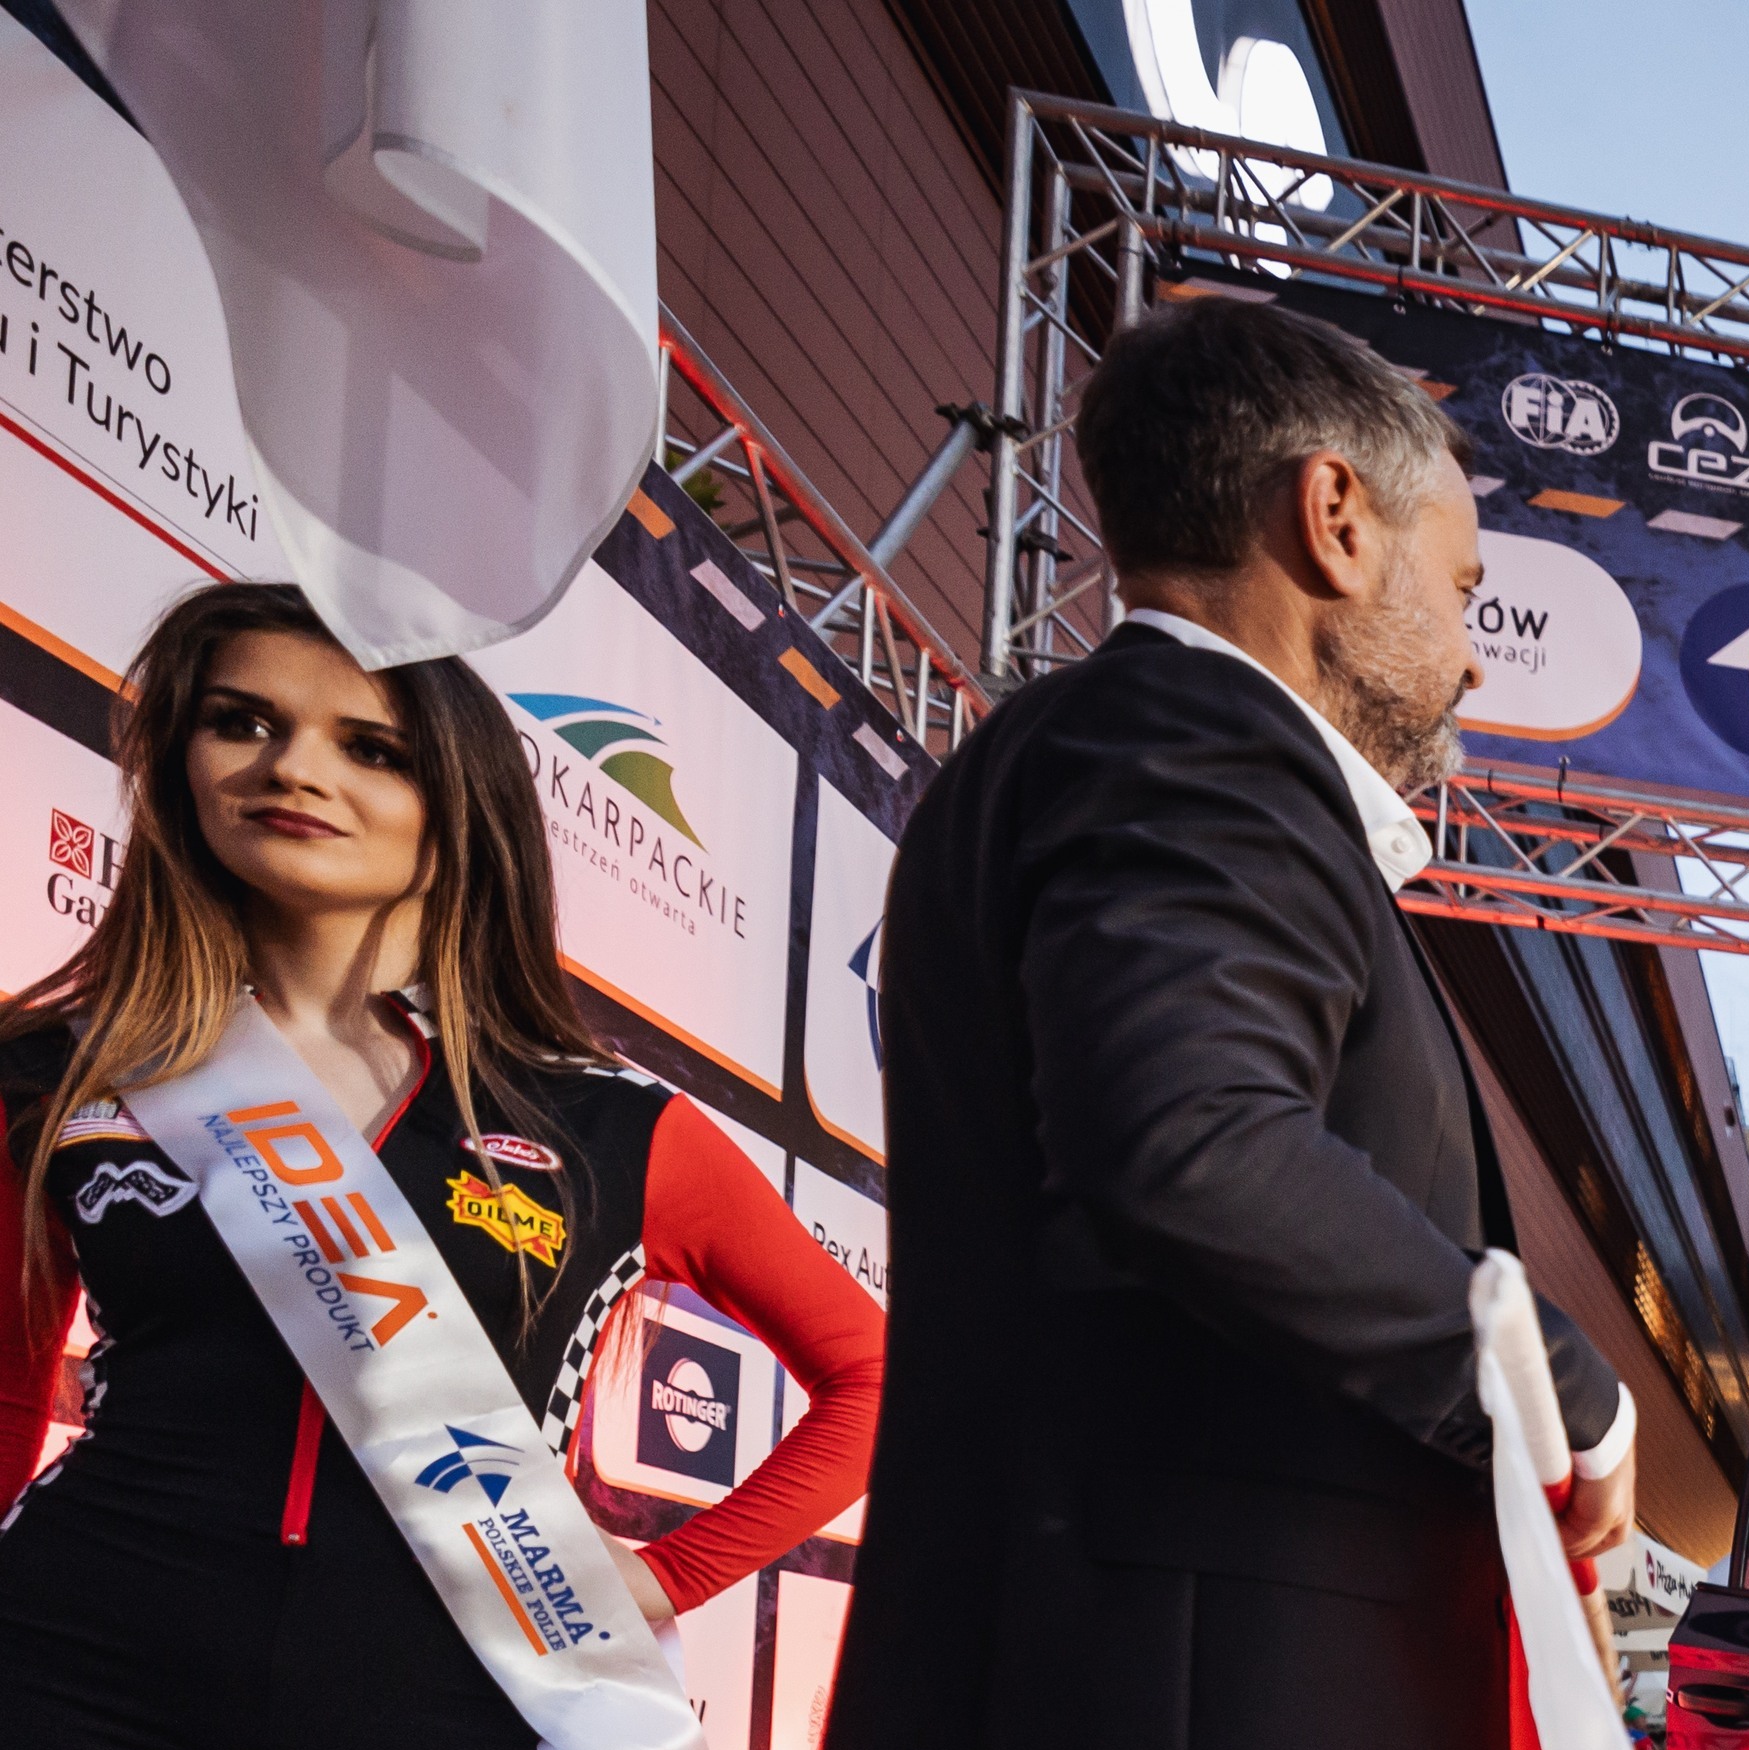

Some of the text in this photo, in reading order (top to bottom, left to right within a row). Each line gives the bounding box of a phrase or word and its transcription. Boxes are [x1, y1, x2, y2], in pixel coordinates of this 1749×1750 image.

[0, 227, 171, 394] erstwo
[57, 342, 258, 541] Turystyki
[1472, 641, 1546, 675] wacji
[519, 729, 747, 940] DKARPACKIE
[548, 815, 697, 937] estrzeń otwarta
[197, 1112, 376, 1352] NAJLEPSZY PRODUKT
[859, 1251, 889, 1293] Aut
[652, 1379, 728, 1431] ROTINGER
[478, 1516, 568, 1652] POLSKIE FOLIE
[500, 1507, 594, 1646] MARMA
